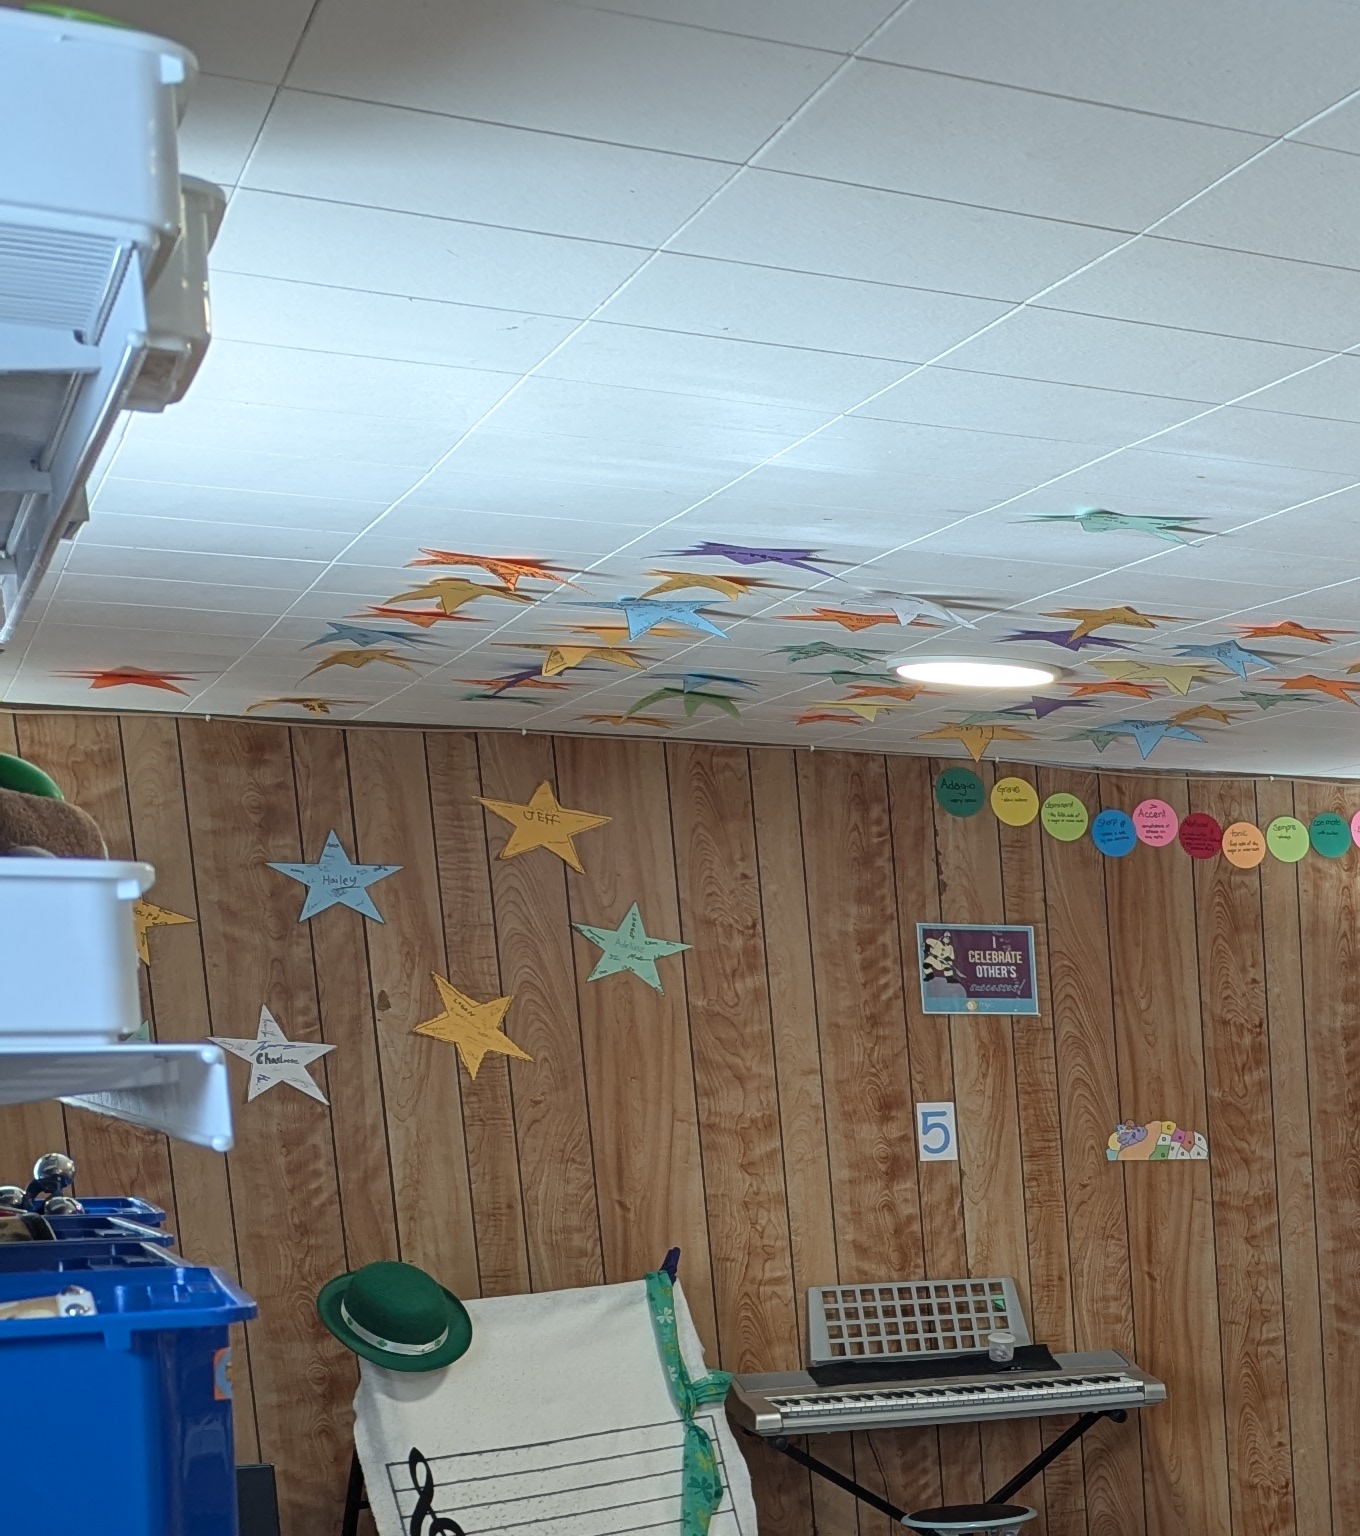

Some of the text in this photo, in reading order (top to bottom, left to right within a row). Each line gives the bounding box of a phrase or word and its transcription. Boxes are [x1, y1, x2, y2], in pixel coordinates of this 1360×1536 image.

[940, 777, 976, 796] Adagio
[1138, 809, 1166, 819] Accent
[322, 874, 357, 887] Hailey
[992, 935, 997, 949] I
[968, 950, 1022, 964] CELEBRATE
[975, 965, 1017, 978] OTHER'S
[921, 1111, 951, 1154] 5
